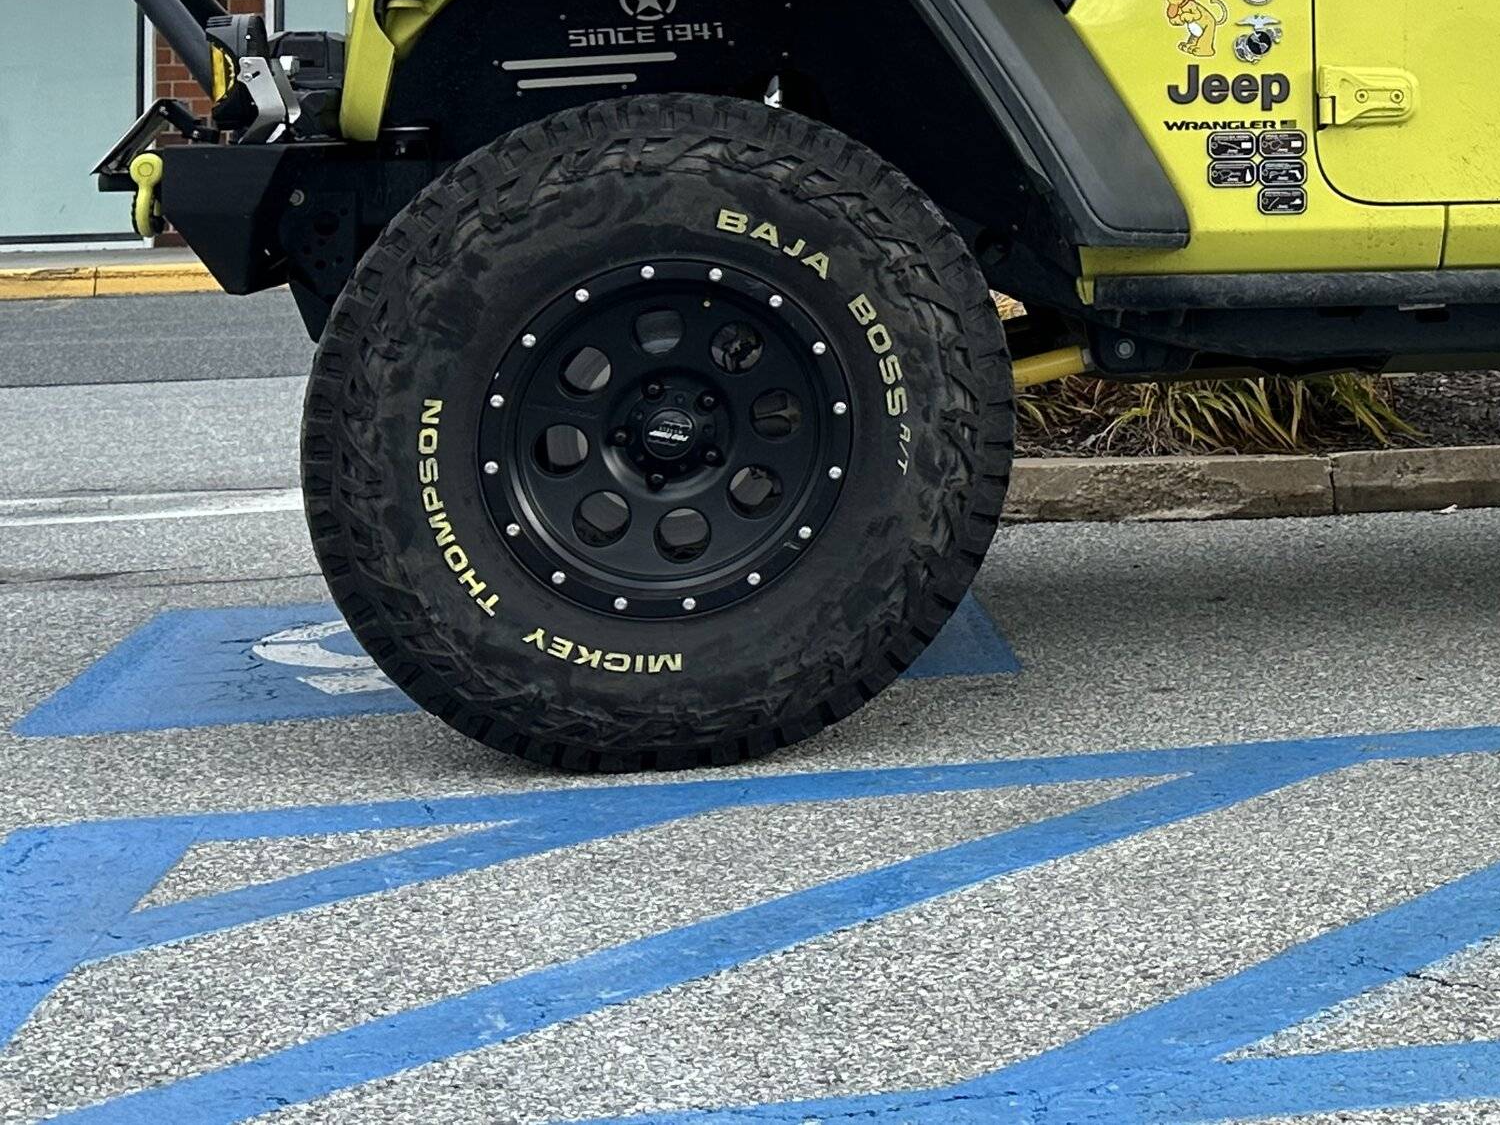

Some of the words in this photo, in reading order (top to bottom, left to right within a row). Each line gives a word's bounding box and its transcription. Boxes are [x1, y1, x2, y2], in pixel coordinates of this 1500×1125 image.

[662, 22, 724, 42] 1941
[1167, 64, 1290, 112] Jeep
[1163, 120, 1276, 131] WRANGLER
[716, 209, 830, 280] BAJA
[847, 293, 908, 416] BOSS
[897, 423, 912, 476] A/T
[417, 398, 500, 618] THOMPSON
[521, 627, 683, 673] MICKEY
